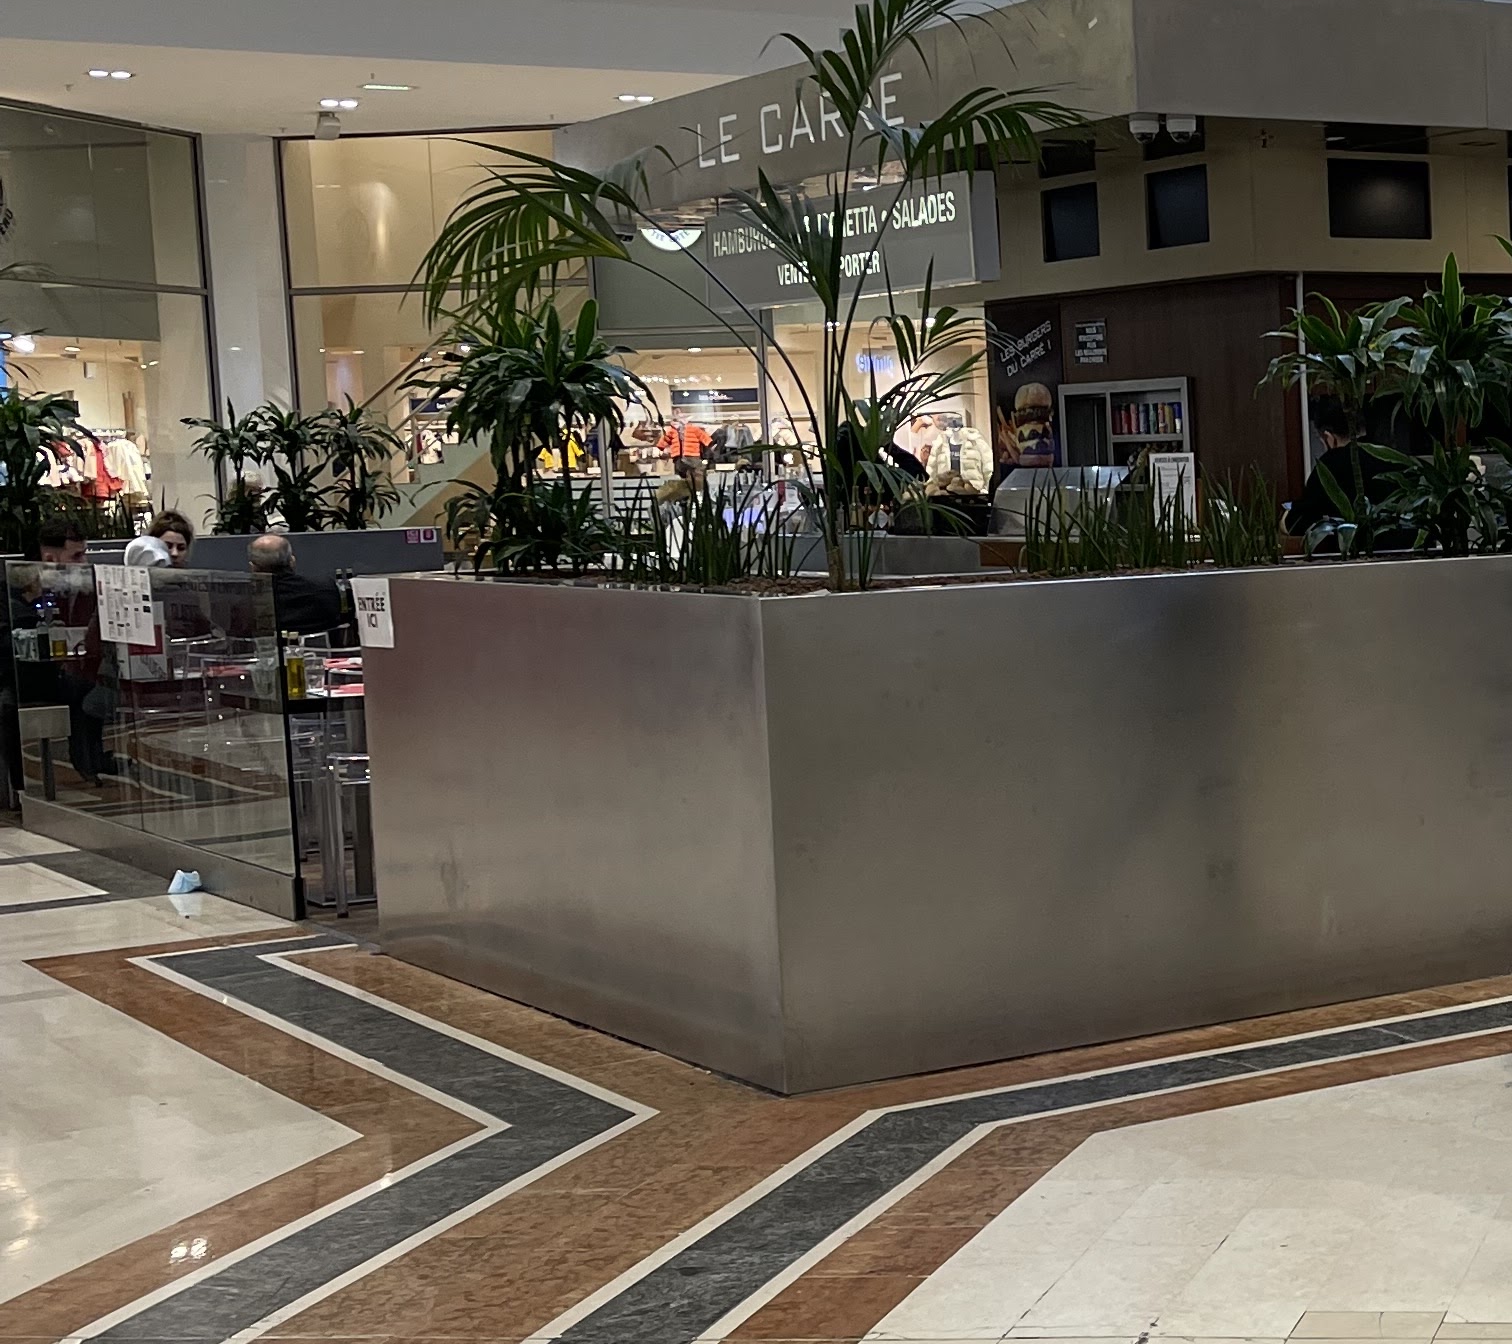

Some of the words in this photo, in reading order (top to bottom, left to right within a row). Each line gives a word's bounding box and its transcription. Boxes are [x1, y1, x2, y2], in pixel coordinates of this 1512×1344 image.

[696, 113, 741, 169] LE
[892, 191, 957, 230] SALADES
[1000, 346, 1016, 363] LES
[1016, 320, 1052, 351] BURGERS
[1006, 361, 1019, 377] DU
